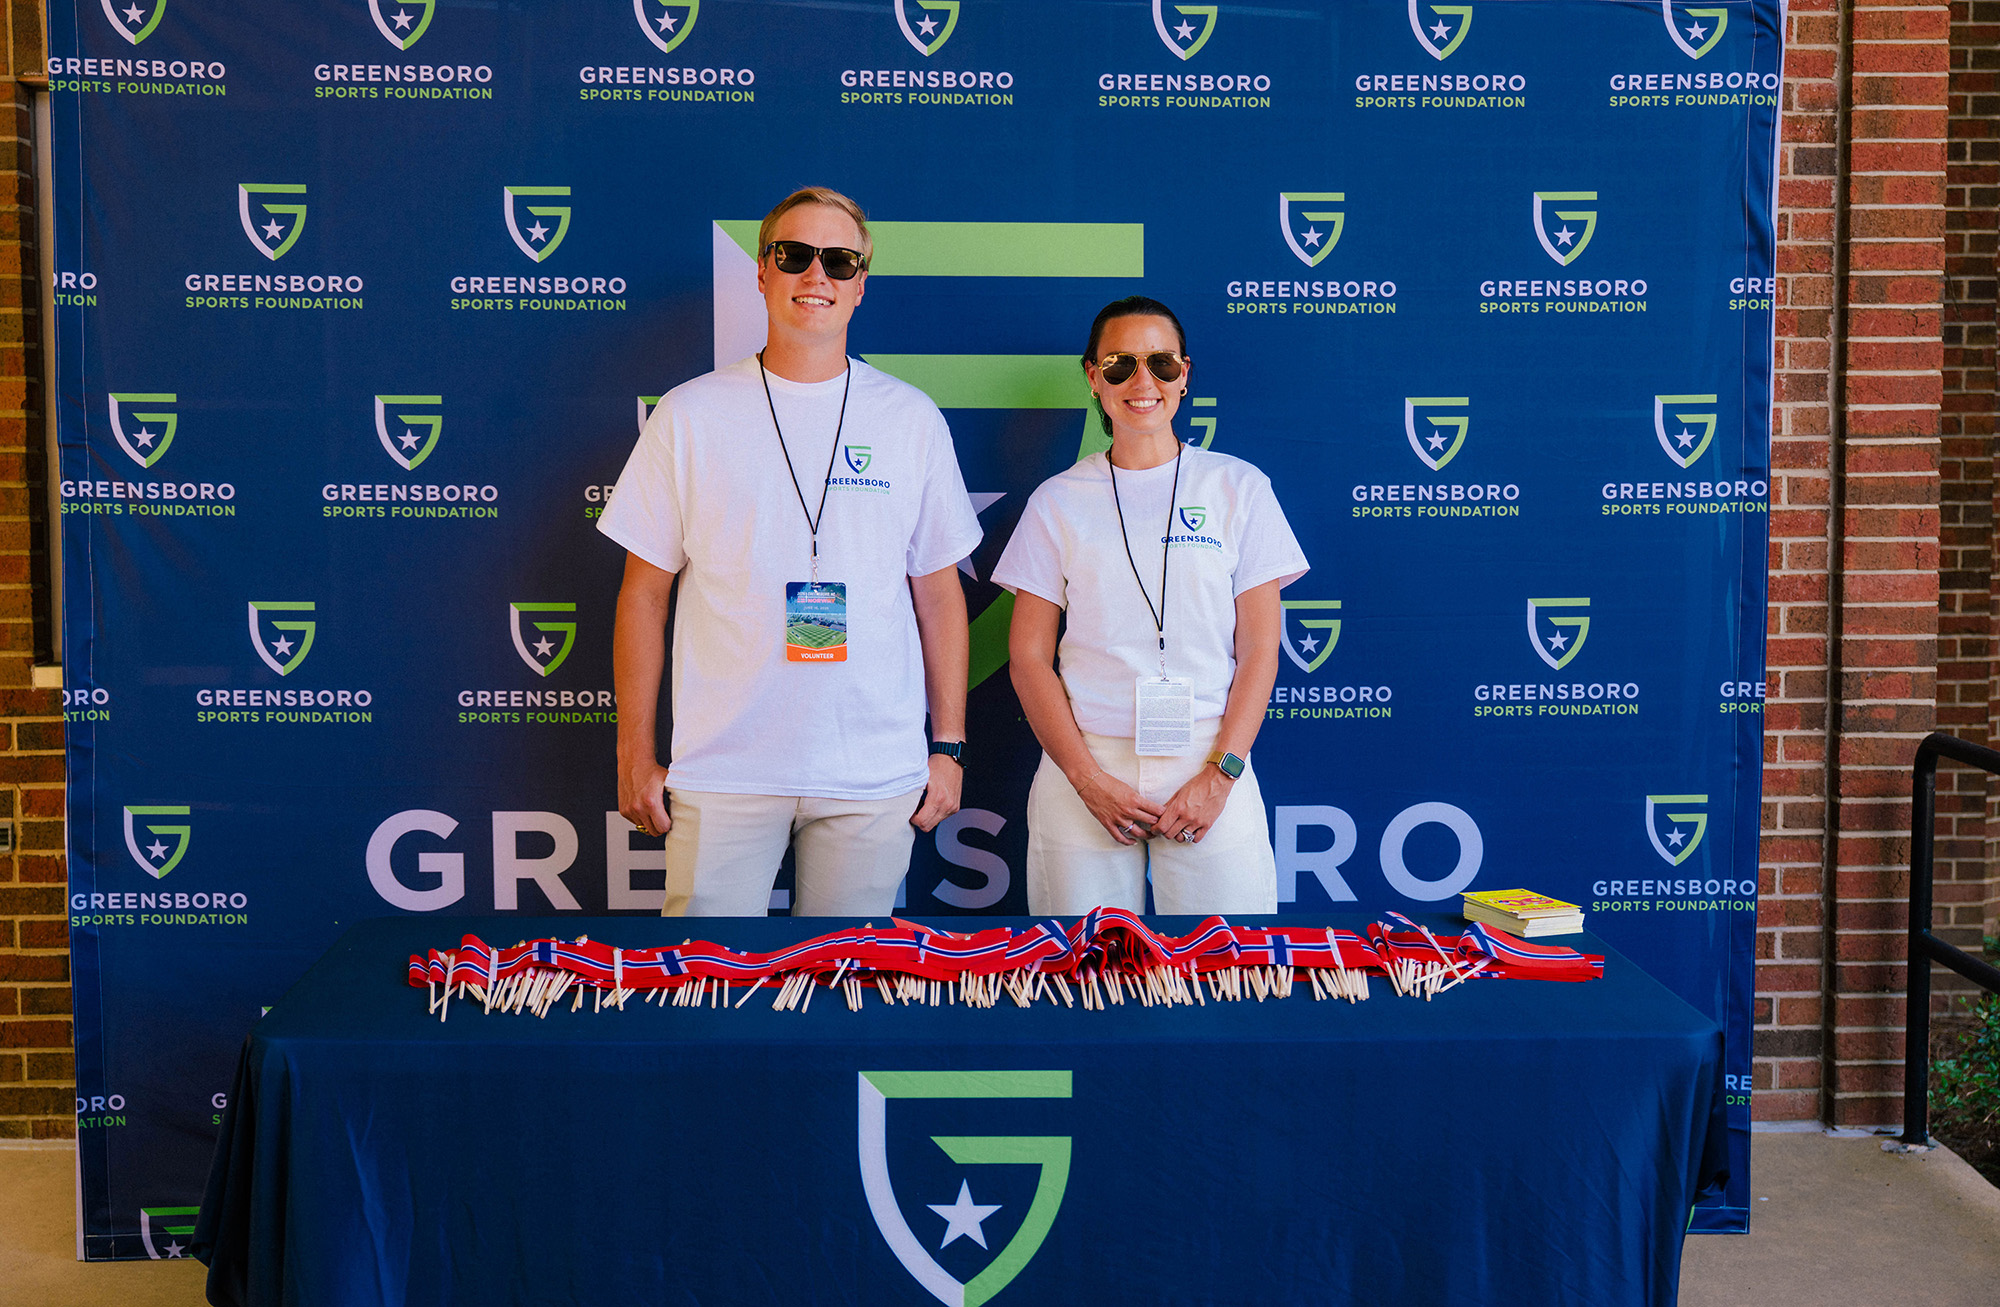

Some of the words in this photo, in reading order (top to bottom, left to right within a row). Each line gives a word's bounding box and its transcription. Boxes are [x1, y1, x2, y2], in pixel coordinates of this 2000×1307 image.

[48, 57, 226, 79] GREENSBORO
[314, 64, 492, 83] GREENSBORO
[579, 66, 755, 86] GREENSBORO
[840, 70, 1013, 89] GREENSBORO
[1098, 74, 1271, 92] GREENSBORO
[1355, 74, 1526, 92] GREENSBORO
[1609, 72, 1779, 91] GREENSBORO
[48, 80, 111, 97] SPORTS
[118, 80, 226, 97] FOUNDATION
[314, 86, 378, 99] SPORTS
[384, 86, 492, 99] FOUNDATION
[579, 88, 642, 102] SPORTS
[648, 88, 755, 102] FOUNDATION
[840, 92, 902, 105] SPORTS
[908, 92, 1013, 105] FOUNDATION
[1098, 95, 1159, 108] SPORTS
[1166, 95, 1271, 108] FOUNDATION
[1355, 96, 1415, 108] SPORTS
[1422, 96, 1525, 108] FOUNDATION
[1609, 93, 1669, 107] SPORTS
[1676, 93, 1777, 107] FOUNDATION
[185, 274, 364, 293] GREENSBORO
[450, 276, 627, 294] GREENSBORO
[1226, 280, 1397, 298] GREENSBORO
[1479, 279, 1648, 297] GREENSBORO
[185, 296, 248, 309] SPORTS
[255, 296, 363, 309] FOUNDATION
[450, 298, 513, 311] SPORTS
[519, 298, 626, 311] FOUNDATION
[1226, 302, 1287, 314] SPORTS
[1293, 302, 1396, 314] FOUNDATION
[1479, 301, 1539, 313] SPORTS
[1545, 301, 1647, 313] FOUNDATION
[1729, 299, 1773, 311] SPOR
[59, 480, 236, 500] GREENSBORO
[322, 484, 497, 502] GREENSBORO
[1352, 484, 1520, 501] GREENSBORO
[1602, 480, 1768, 499] GREENSBORO
[59, 502, 122, 516] SPORTS
[128, 502, 236, 516] FOUNDATION
[322, 506, 385, 519] SPORTS
[391, 506, 497, 519] FOUNDATION
[1352, 505, 1411, 518] SPORTS
[1418, 505, 1519, 518] FOUNDATION
[1602, 501, 1660, 515] SPORTS
[1666, 501, 1767, 515] FOUNDATION
[196, 689, 372, 707] GREENSBORO
[457, 690, 617, 707] GREENSBOR
[1270, 683, 1393, 702] ENSBORO
[1474, 683, 1640, 701] GREENSBORO
[196, 711, 259, 724] SPORTS
[265, 711, 372, 724] FOUNDATION
[458, 712, 520, 724] SPORTS
[526, 712, 618, 724] FOUNDATIO
[1291, 705, 1392, 718] FOUNDATION
[1474, 704, 1532, 717] SPORTS
[1539, 704, 1639, 717] FOUNDATION
[1592, 879, 1756, 896] GREENSBORO
[70, 892, 248, 910] GREENSBORO
[1592, 900, 1649, 912] SPORTS
[1656, 900, 1756, 912] FOUNDATION
[71, 913, 134, 927] SPORTS
[140, 913, 248, 927] FOUNDATION
